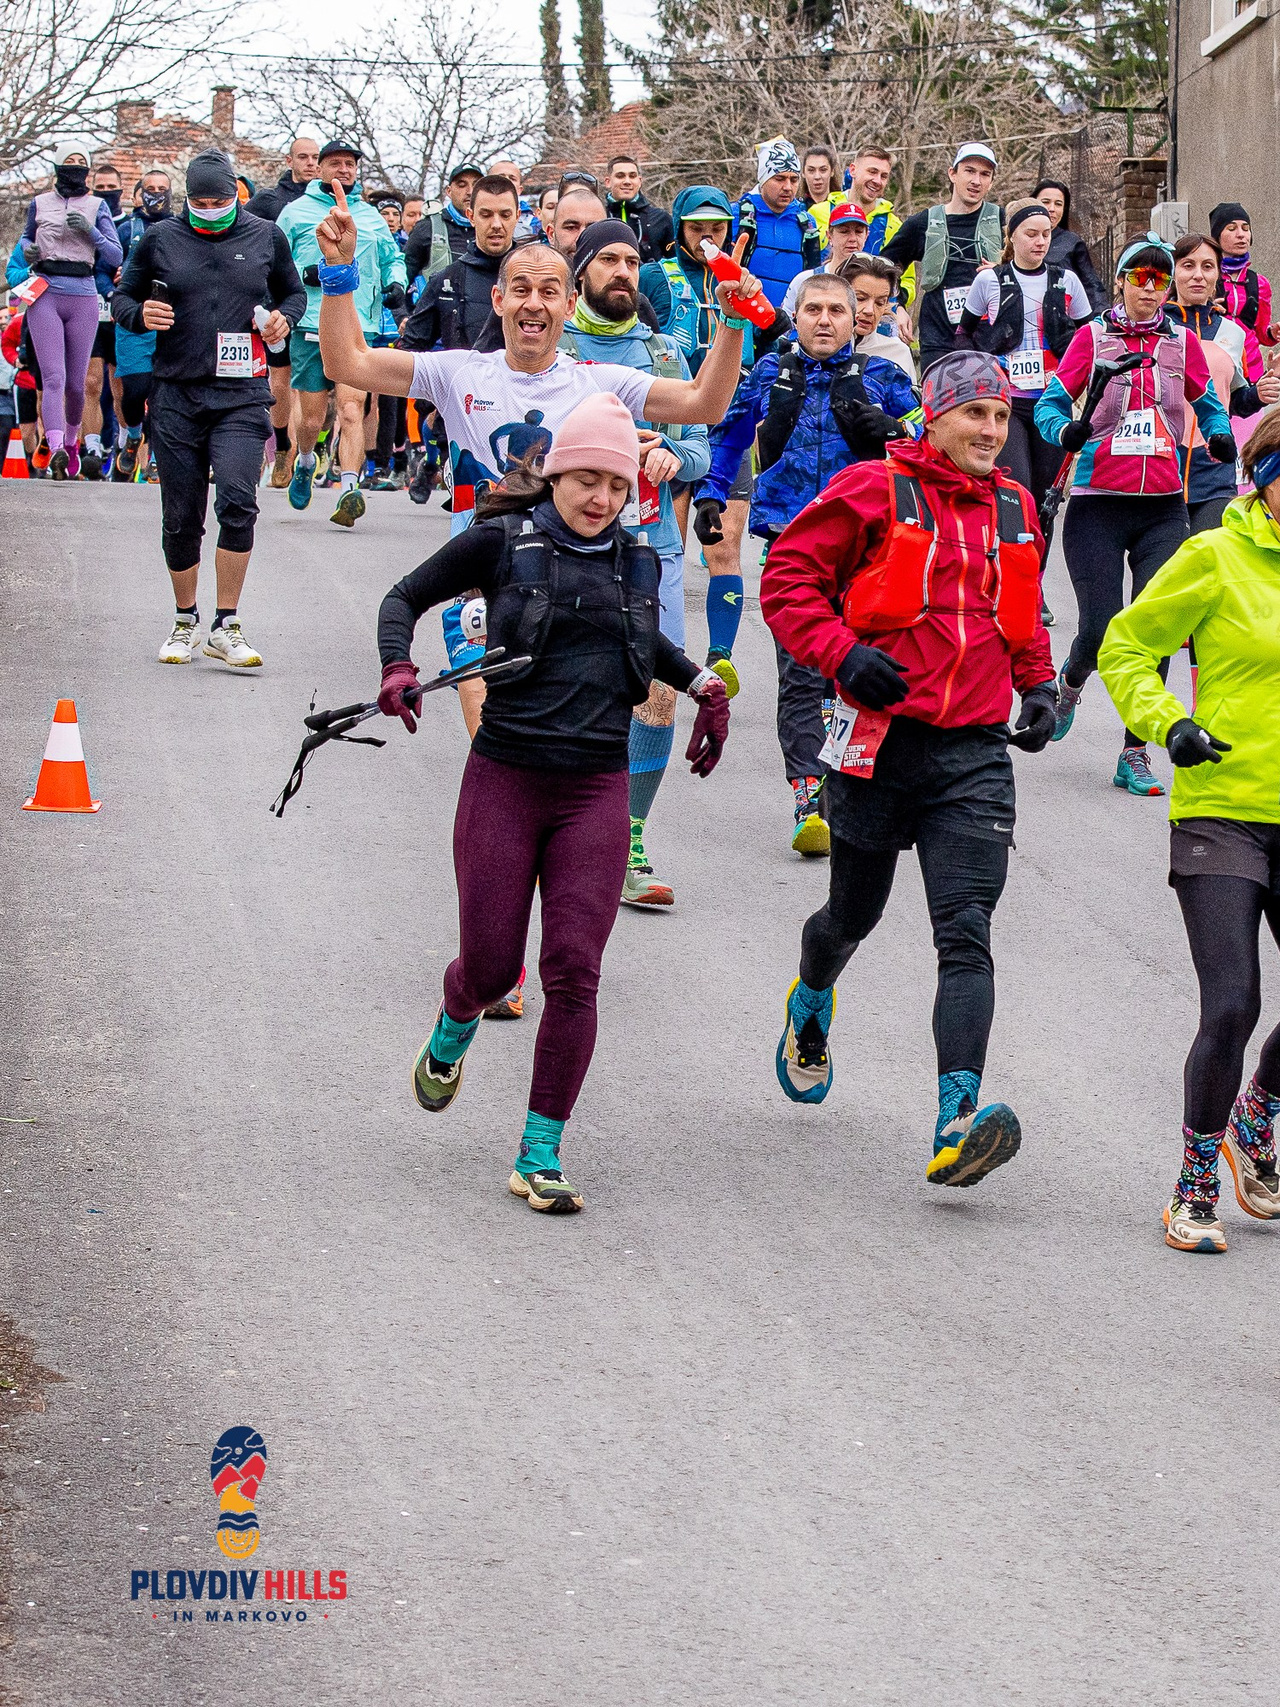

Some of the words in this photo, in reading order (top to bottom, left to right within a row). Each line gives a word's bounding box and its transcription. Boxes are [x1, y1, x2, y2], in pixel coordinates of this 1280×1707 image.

[221, 346, 249, 361] 2313
[1012, 361, 1040, 375] 2109
[1115, 422, 1152, 438] 2244
[844, 752, 861, 760] STEP
